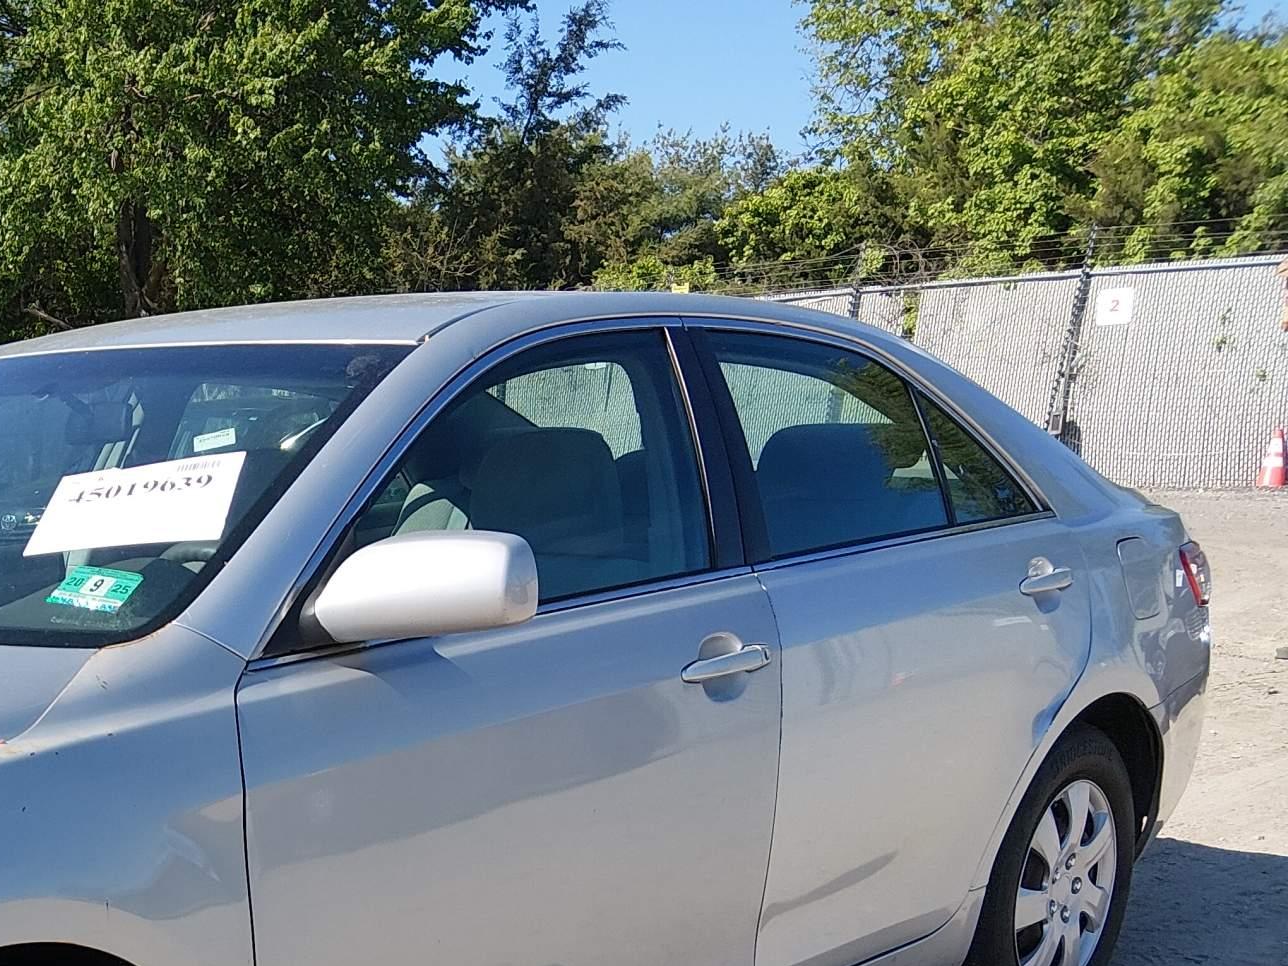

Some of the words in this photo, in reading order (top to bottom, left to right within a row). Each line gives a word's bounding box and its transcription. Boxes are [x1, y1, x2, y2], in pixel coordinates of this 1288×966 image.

[1110, 299, 1120, 312] 2
[68, 474, 213, 503] 45019639
[66, 576, 86, 588] 20
[89, 578, 105, 593] 9
[110, 583, 132, 596] 25
